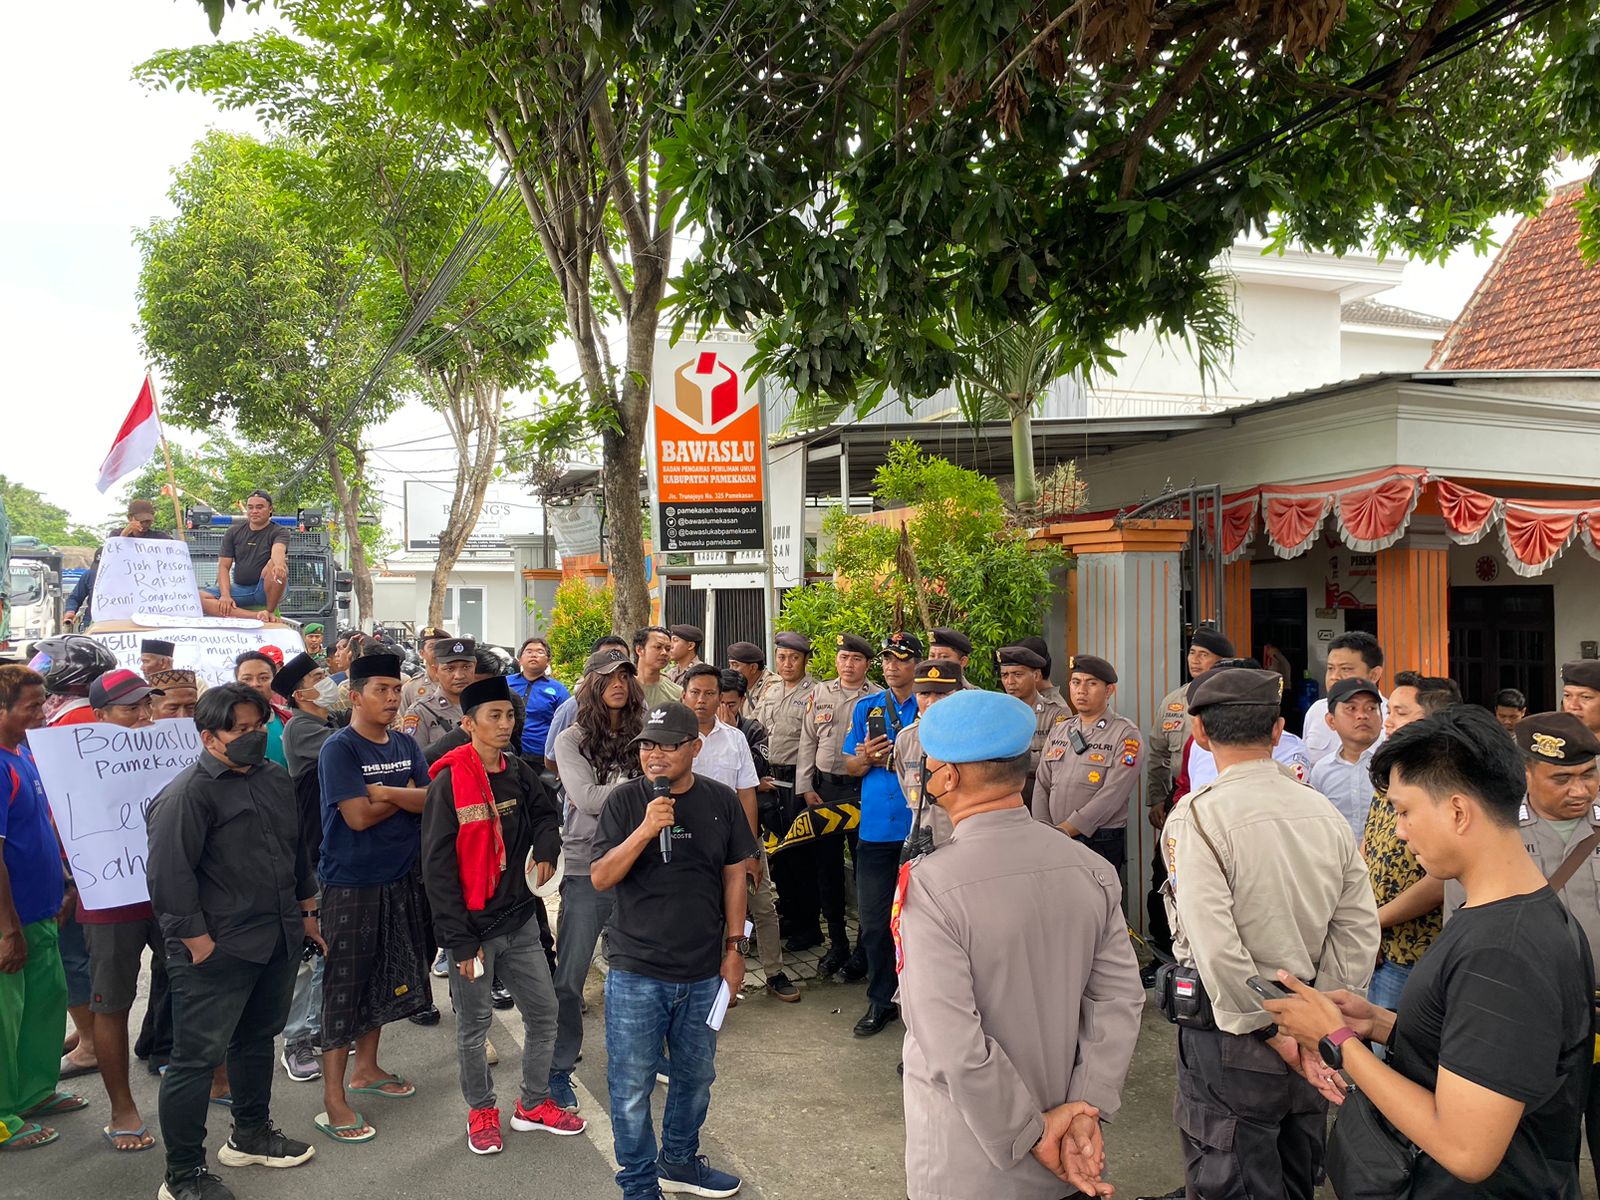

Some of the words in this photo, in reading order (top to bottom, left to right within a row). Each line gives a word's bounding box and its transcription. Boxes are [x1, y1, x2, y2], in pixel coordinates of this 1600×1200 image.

[661, 440, 755, 462] BAWASLU
[663, 475, 708, 484] KABUPATEN
[710, 475, 756, 483] PAMEKASAN
[679, 493, 704, 501] Trunojoyo
[677, 506, 757, 514] pamekasan.bawaslu.go.id
[678, 518, 738, 526] @bawaslumekasan
[678, 528, 757, 537] @bawaslukabpamekasan
[706, 539, 741, 548] pamekasan
[72, 723, 198, 760] Bawaslu
[1088, 743, 1113, 751] POLRI
[96, 754, 200, 780] Pamekasan
[361, 764, 381, 772] THE
